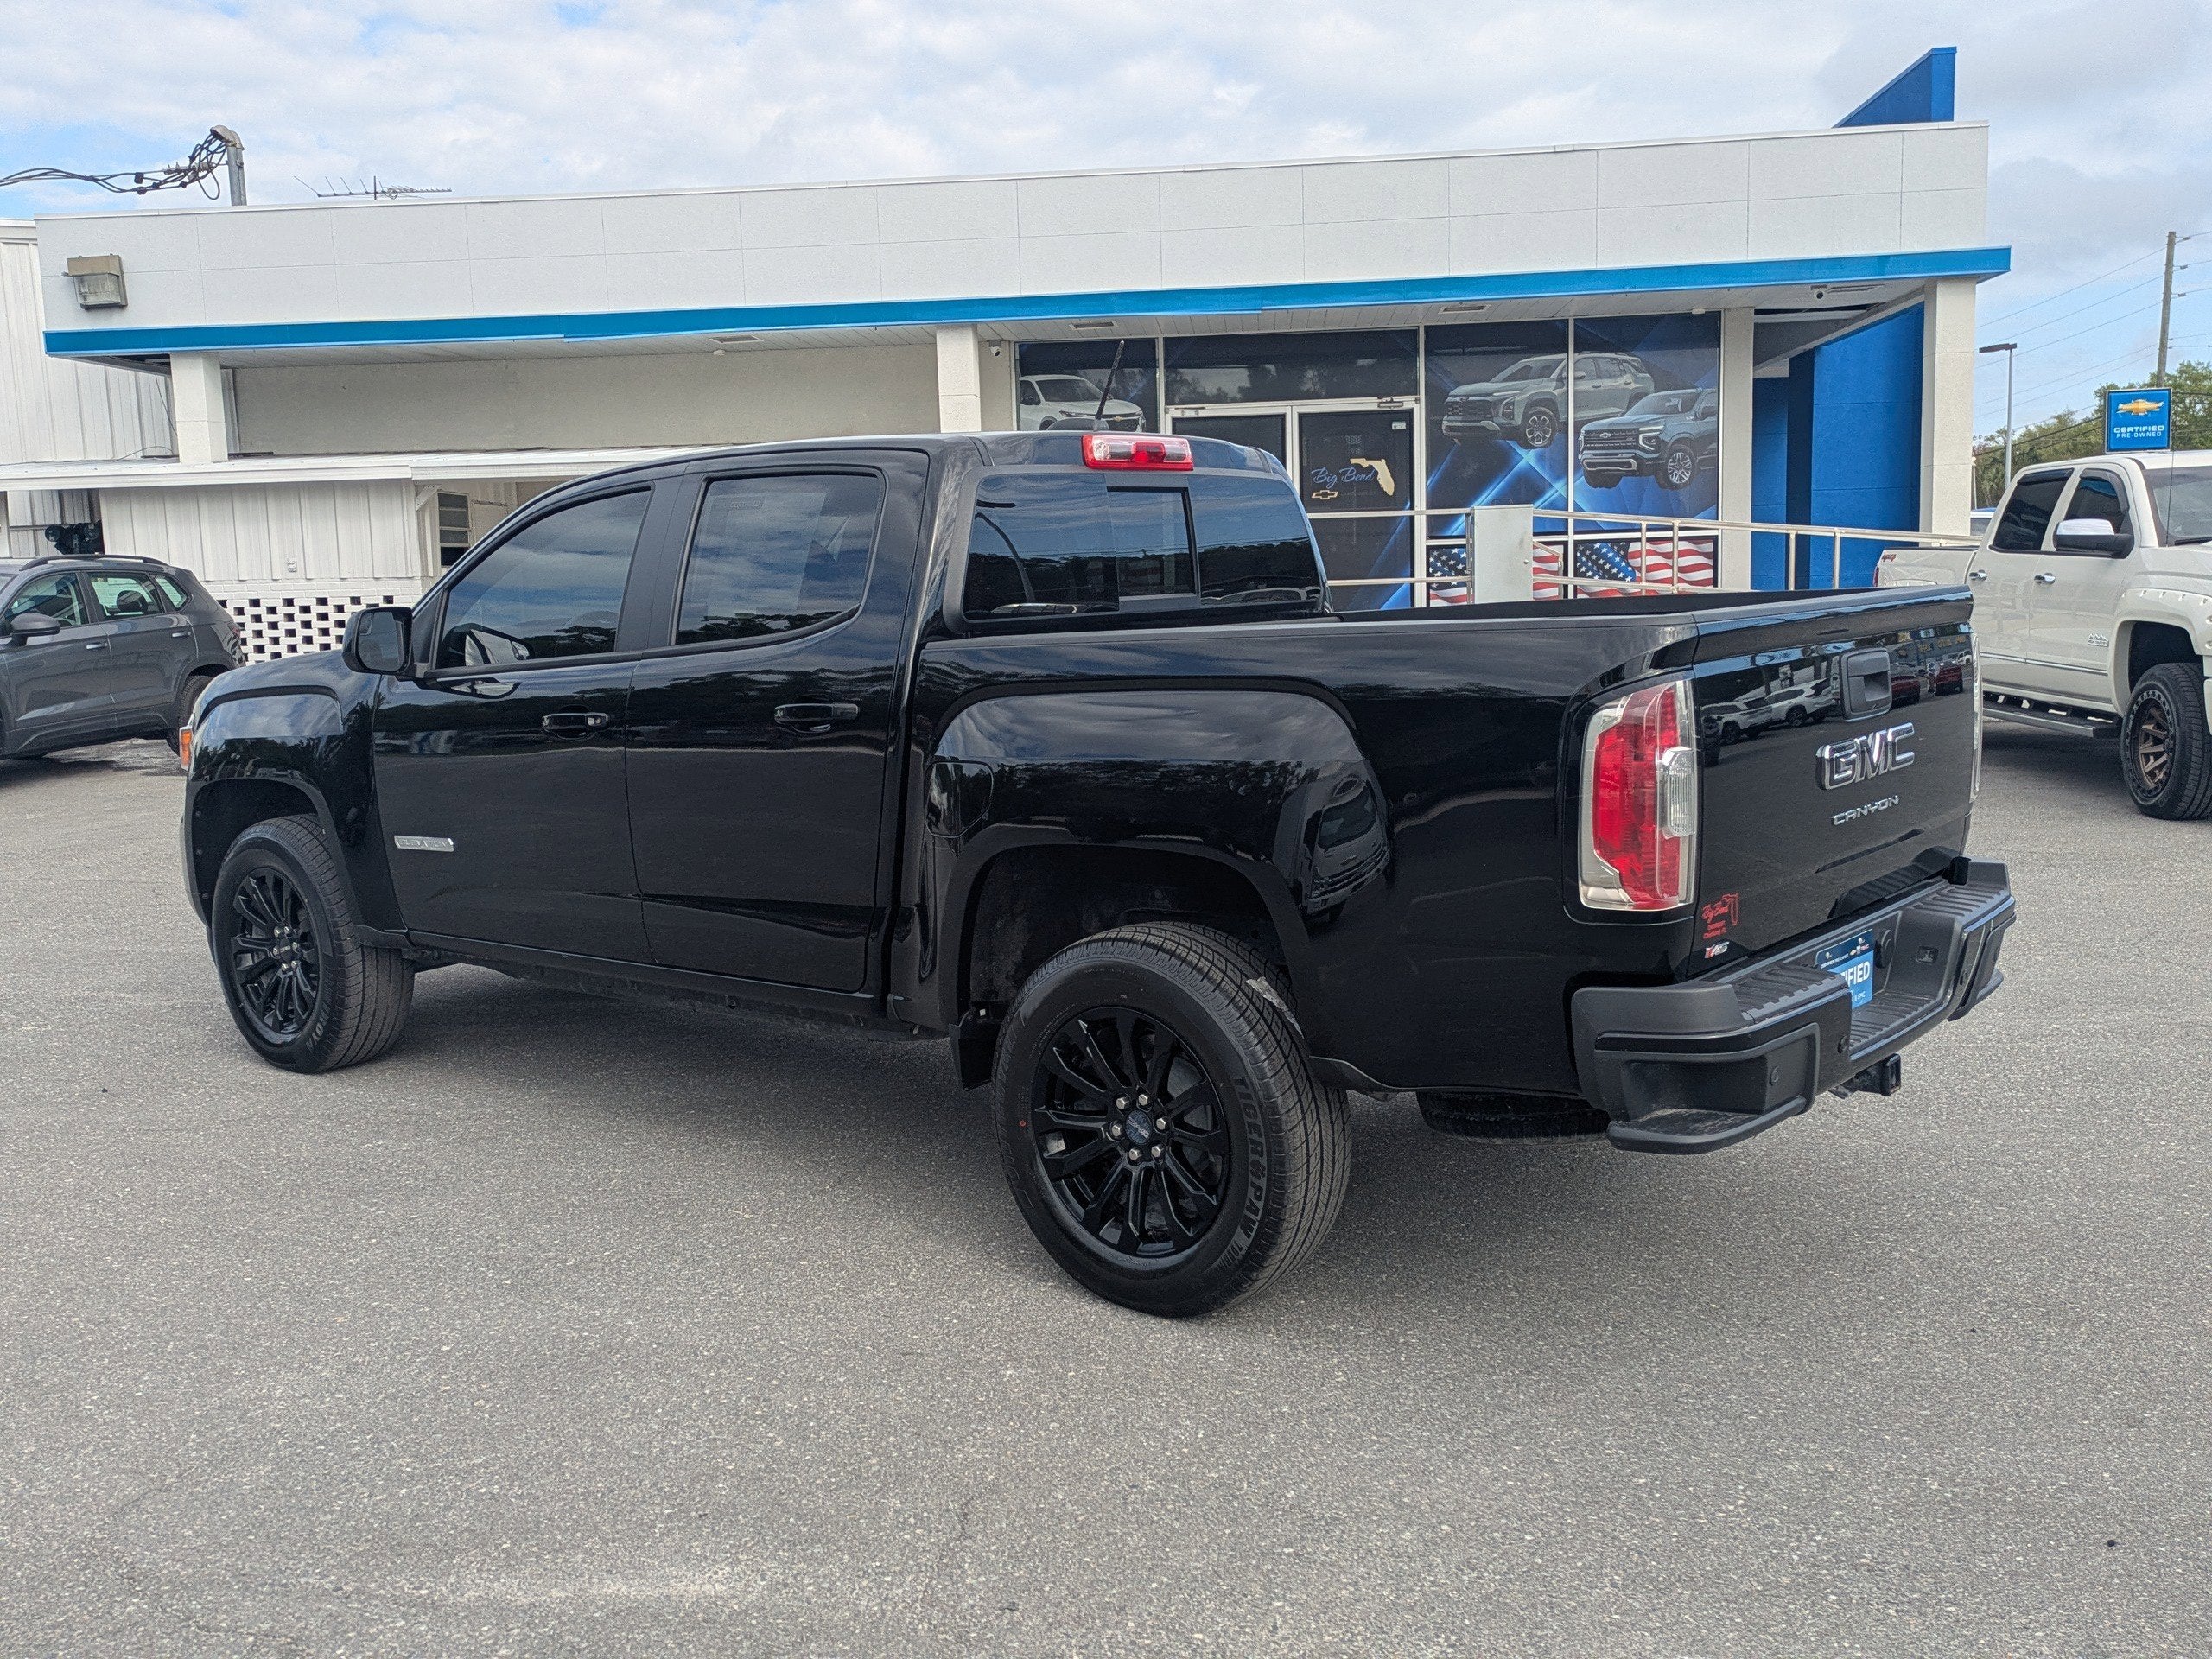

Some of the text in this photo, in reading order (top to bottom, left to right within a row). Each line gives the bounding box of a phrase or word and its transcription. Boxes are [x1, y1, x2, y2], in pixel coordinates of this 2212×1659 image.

[1311, 467, 1376, 489] Big Bend
[1817, 722, 1915, 790] GMC
[1832, 795, 1899, 825] CANYON
[1234, 1077, 1265, 1160] TIGER
[1243, 1179, 1264, 1240] PAW
